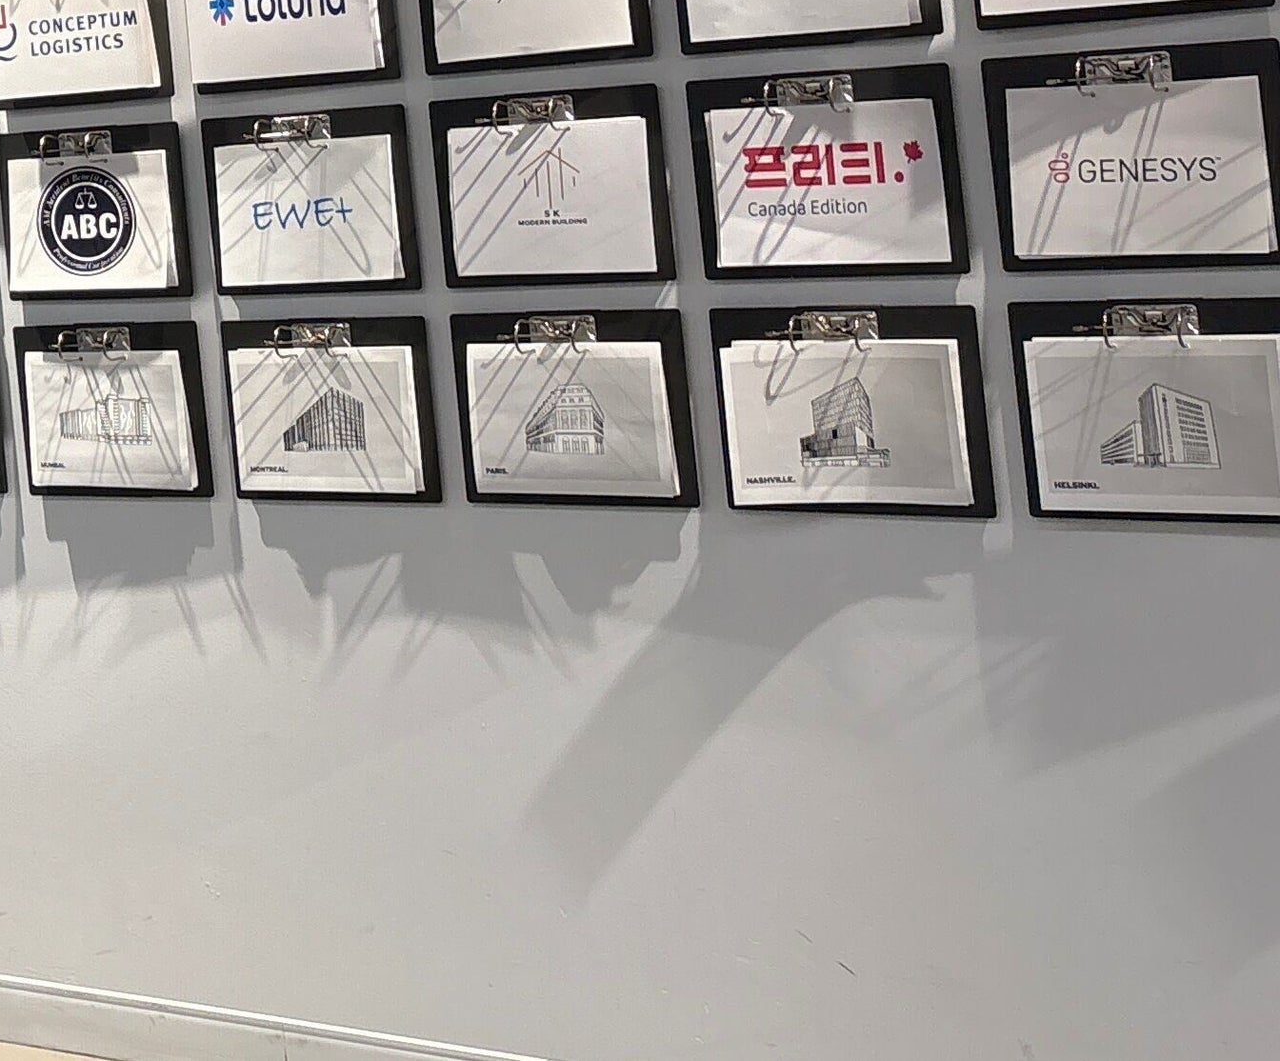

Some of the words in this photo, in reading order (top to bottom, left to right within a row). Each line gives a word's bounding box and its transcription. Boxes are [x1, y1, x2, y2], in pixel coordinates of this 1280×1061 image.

[28, 10, 138, 37] CONCEPTUM
[31, 33, 125, 57] LOGISTICS
[1078, 158, 1218, 183] GENESYS
[747, 200, 806, 217] Canada
[810, 198, 868, 215] Edition
[61, 213, 118, 239] ABC
[518, 218, 550, 226] MODERN
[552, 218, 587, 226] BUILDING
